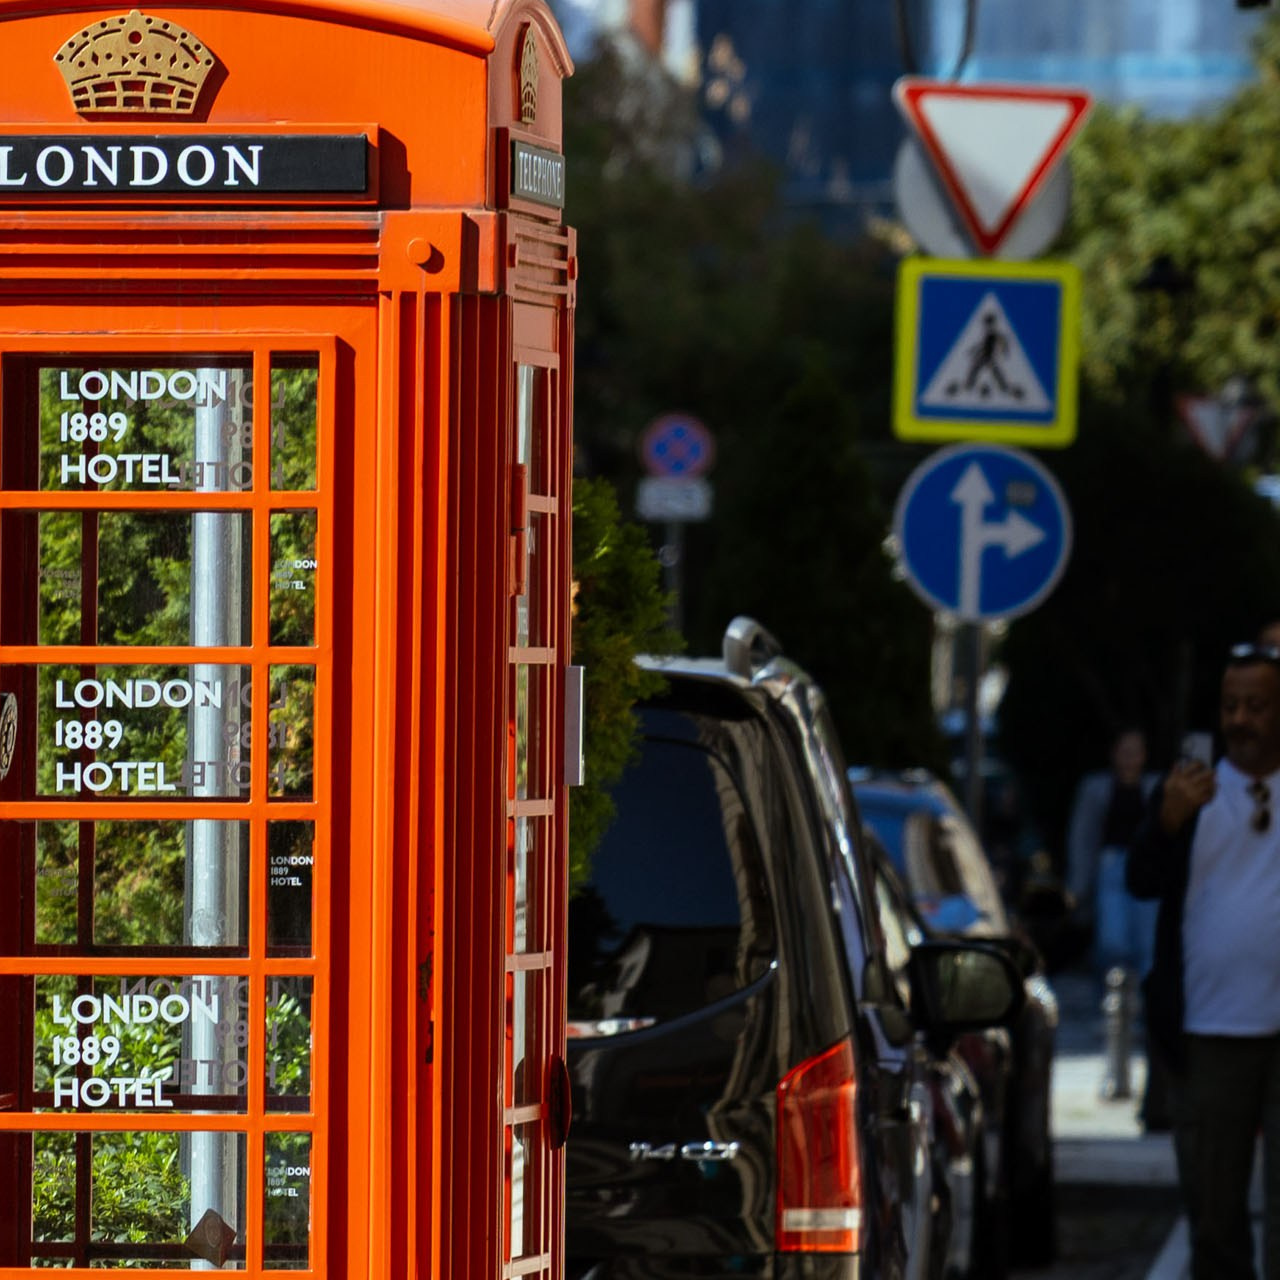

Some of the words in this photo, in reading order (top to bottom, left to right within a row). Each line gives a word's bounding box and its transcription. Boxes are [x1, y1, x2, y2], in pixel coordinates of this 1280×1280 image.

[519, 151, 562, 199] TELEPHONE
[60, 370, 226, 401] LONDON
[60, 411, 128, 442] 1889
[60, 454, 180, 484] HOTEL
[56, 679, 222, 709] LONDON
[55, 719, 123, 750] 1889
[56, 762, 176, 792] HOTEL
[271, 856, 314, 865] LONDON
[271, 877, 302, 886] HOTEL
[53, 993, 218, 1024] LONDON
[53, 1035, 120, 1066] 1889
[54, 1077, 174, 1108] HOTEL
